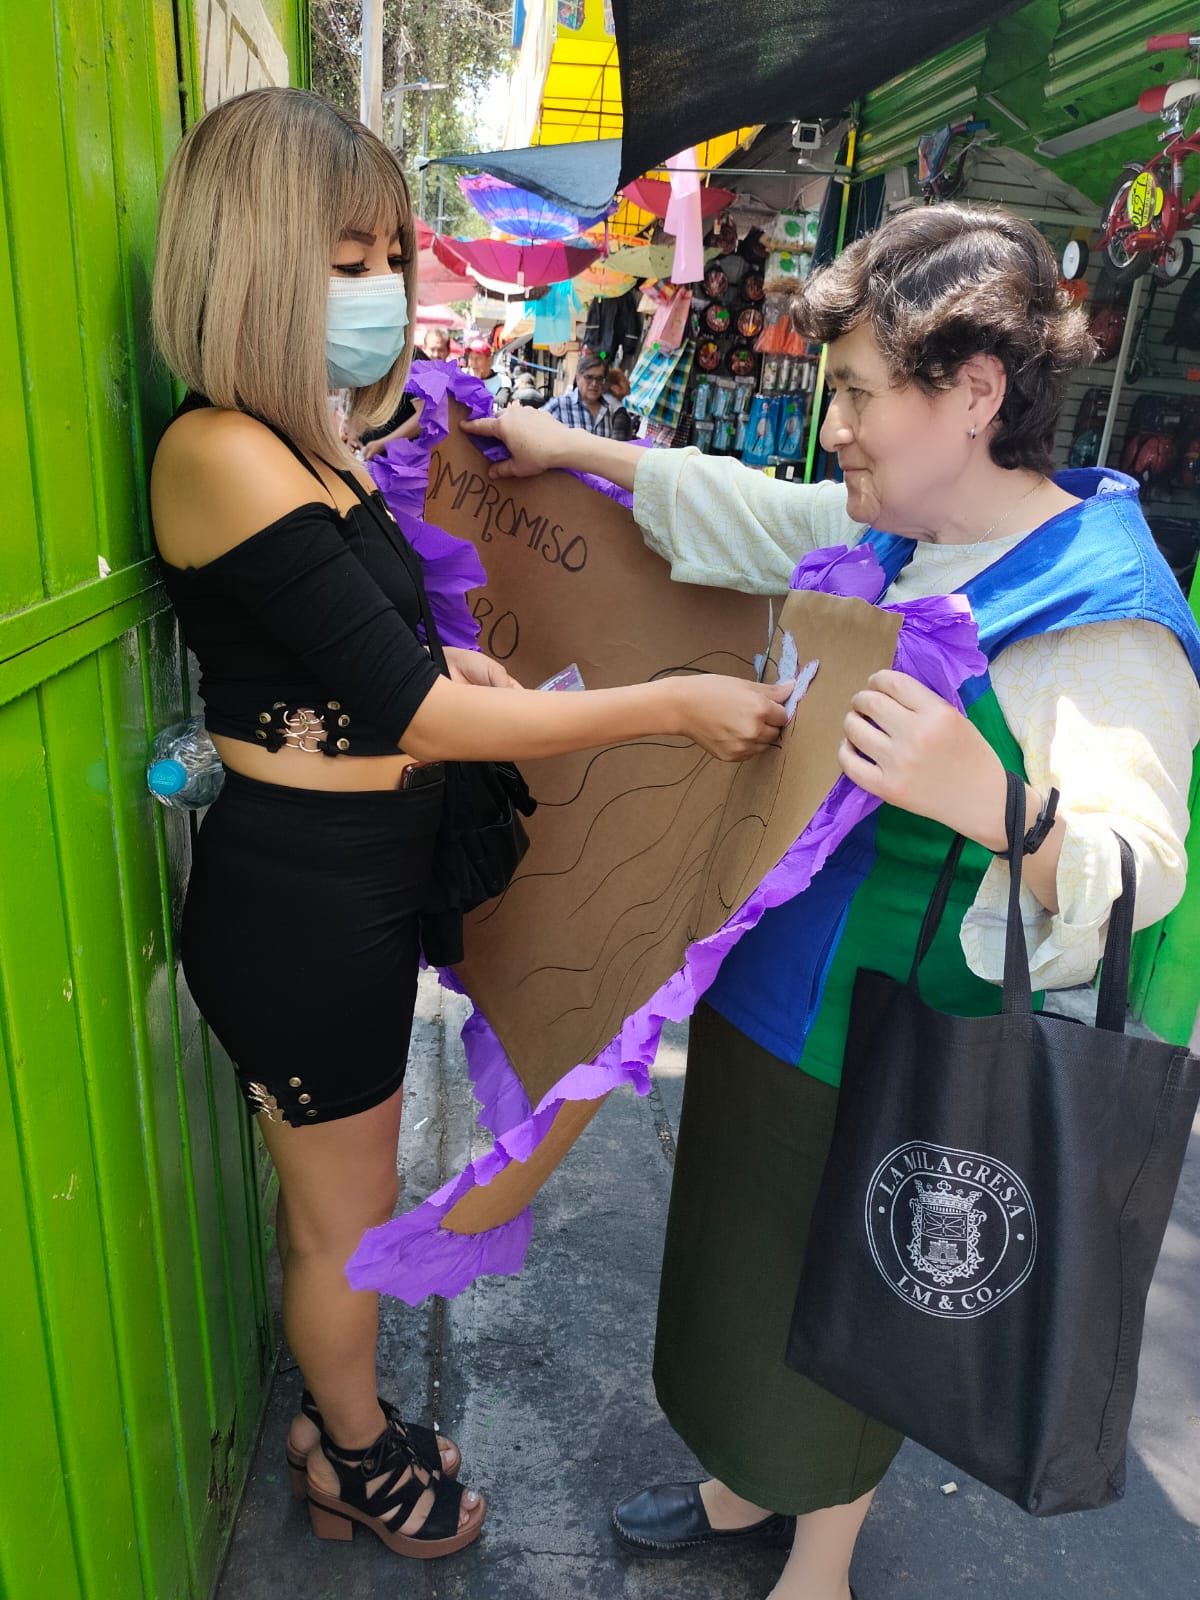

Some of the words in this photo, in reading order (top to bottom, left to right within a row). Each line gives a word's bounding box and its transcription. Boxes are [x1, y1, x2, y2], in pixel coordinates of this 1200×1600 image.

[426, 450, 588, 572] OMPROMISO
[879, 1165, 905, 1197] LA
[903, 1151, 1026, 1219] MILAGRESA
[896, 1275, 932, 1306] LM
[938, 1295, 954, 1311] &
[961, 1286, 1001, 1310] CO.
